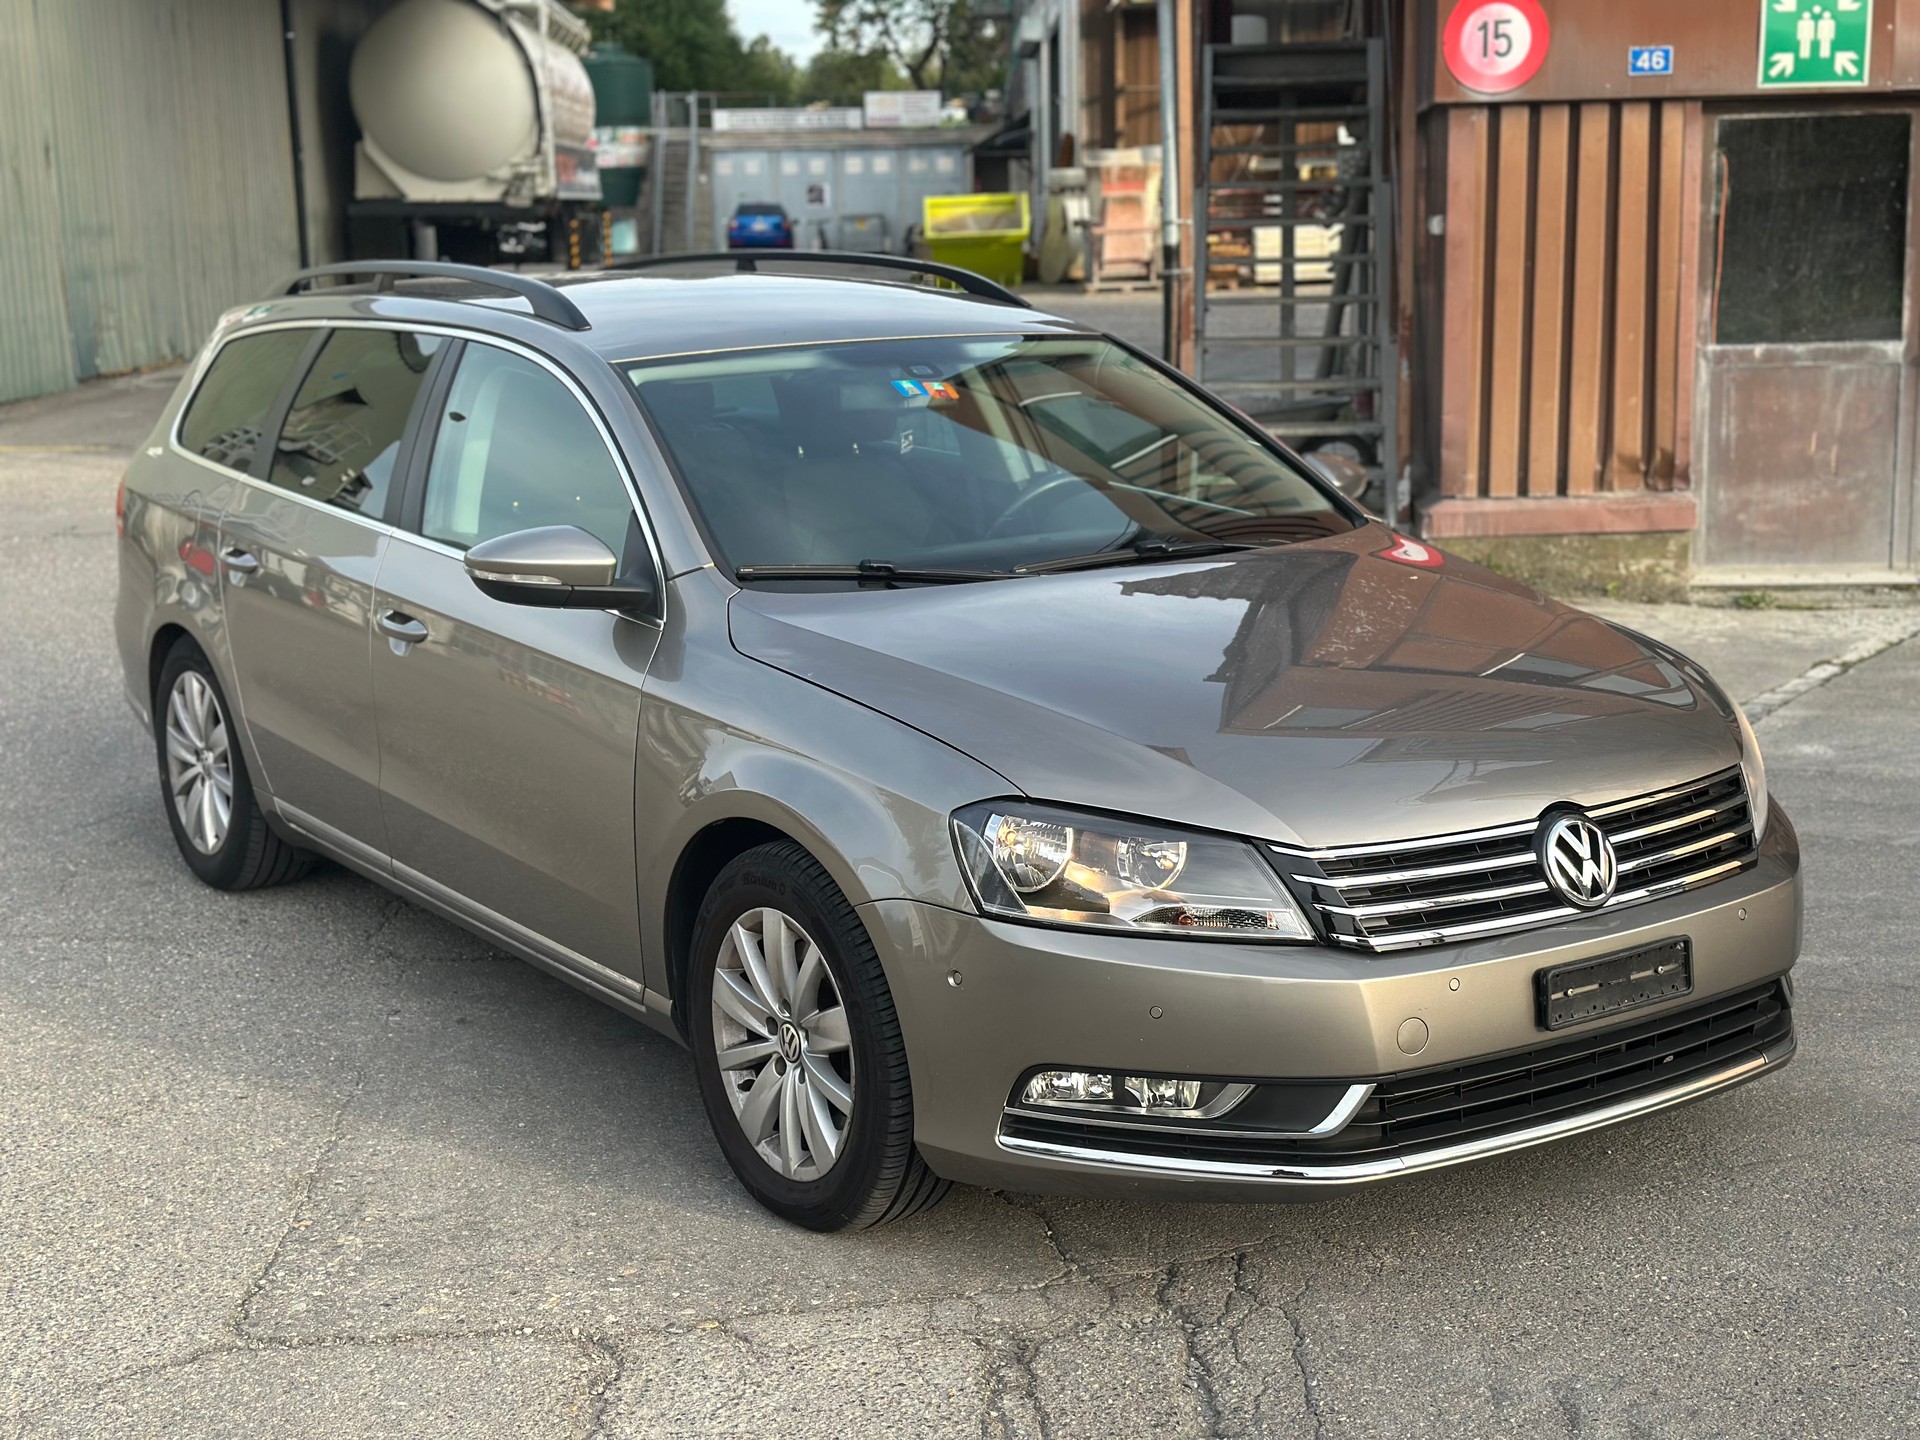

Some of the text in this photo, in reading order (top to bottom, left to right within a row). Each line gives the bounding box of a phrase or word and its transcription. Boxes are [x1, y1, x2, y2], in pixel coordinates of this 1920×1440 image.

[1477, 19, 1513, 58] 15
[1636, 50, 1665, 70] 46
[1548, 821, 1616, 904] VW
